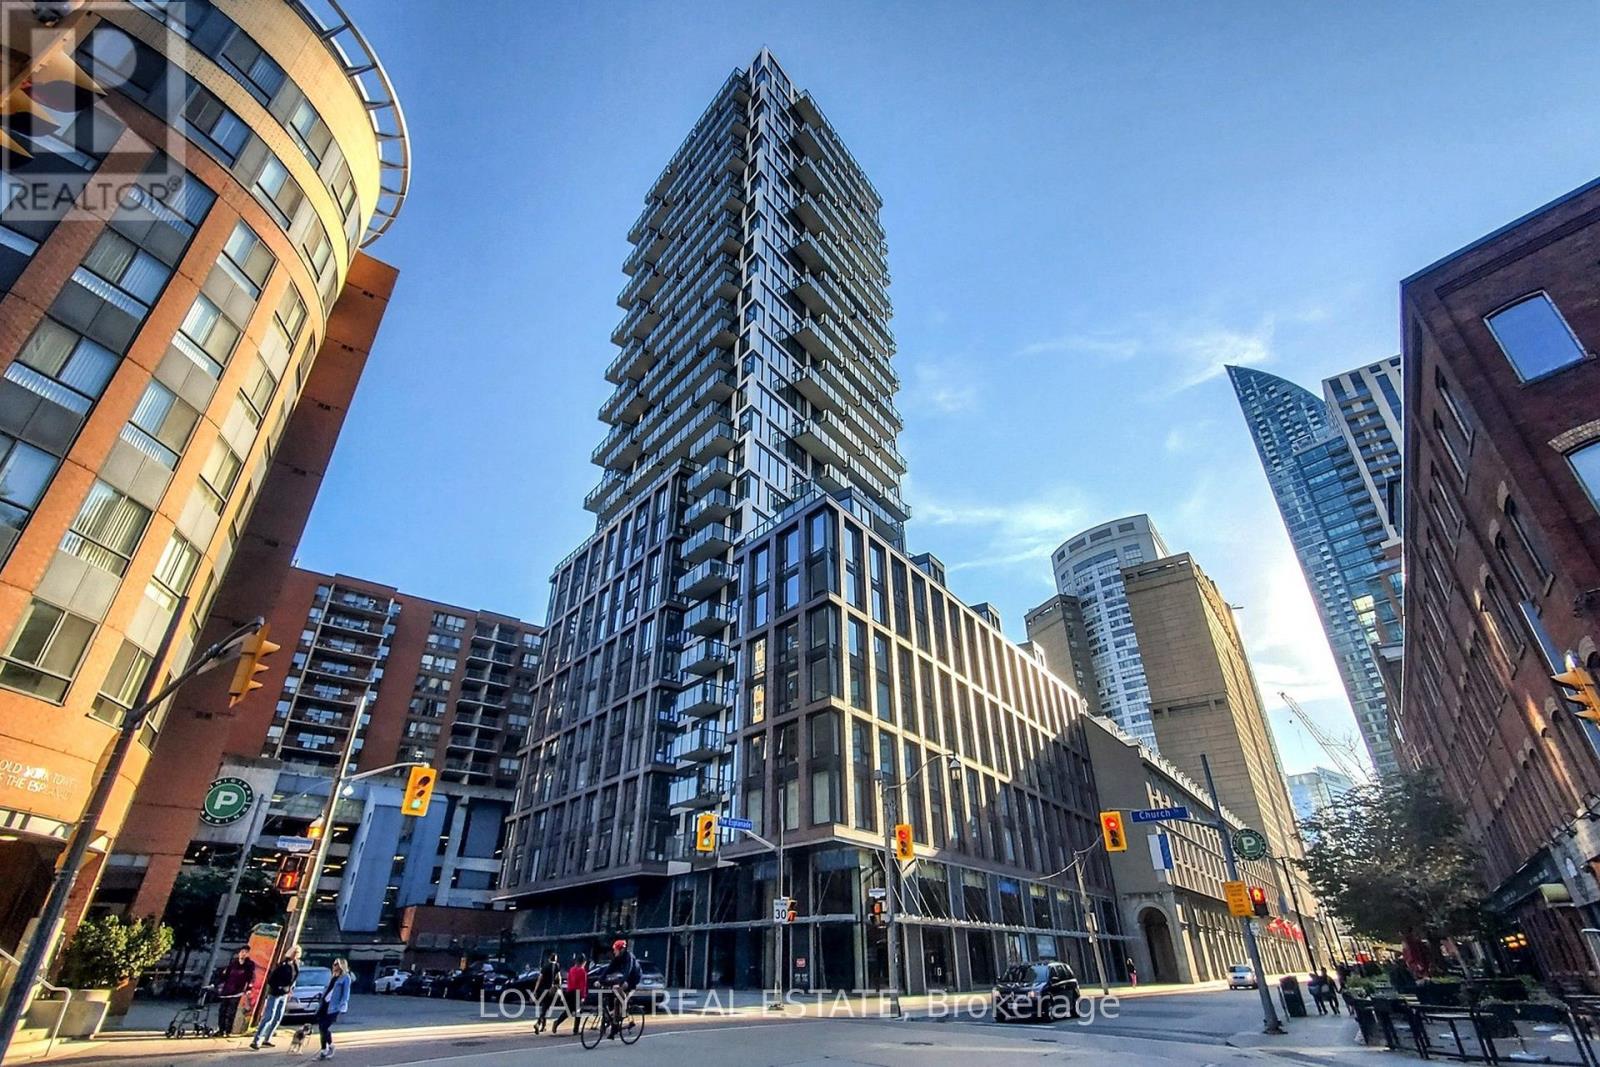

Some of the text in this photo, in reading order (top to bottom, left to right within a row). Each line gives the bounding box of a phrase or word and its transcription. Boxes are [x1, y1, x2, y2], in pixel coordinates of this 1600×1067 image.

[7, 774, 26, 789] THE
[213, 790, 239, 810] P
[1138, 810, 1171, 820] Church
[1241, 836, 1256, 850] P
[775, 909, 787, 920] 30
